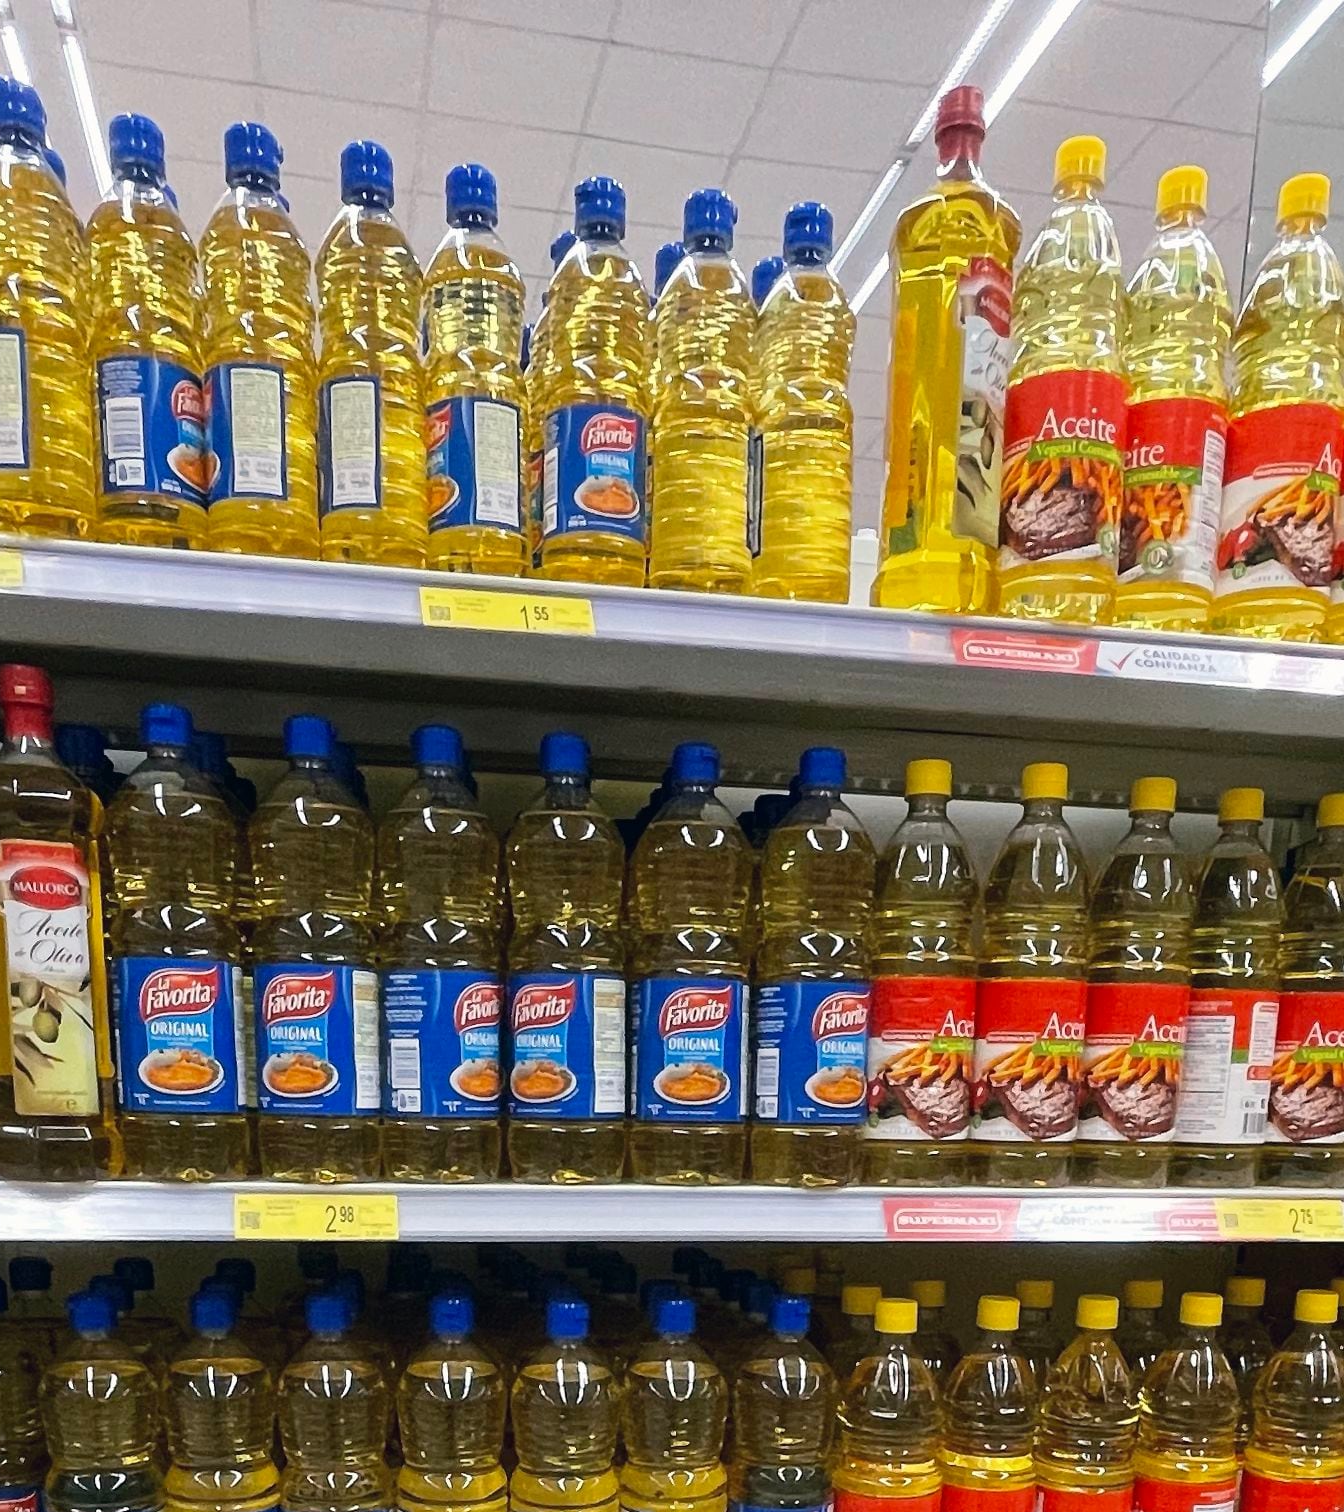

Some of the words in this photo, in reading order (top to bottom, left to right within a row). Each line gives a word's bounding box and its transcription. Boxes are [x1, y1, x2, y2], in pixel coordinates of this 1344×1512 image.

[1036, 407, 1117, 443] Aceite
[587, 426, 634, 449] Favorita
[968, 645, 1075, 663] SUPERMAXI
[1142, 649, 1200, 664] CALIDAD
[1204, 653, 1214, 664] Y
[1134, 658, 1218, 676] CONFIANZA
[13, 880, 81, 897] MALLORCA
[14, 909, 84, 938] Aceite
[29, 939, 85, 965] Oliva
[146, 983, 212, 1015] Favorita
[267, 985, 326, 1019] Favorita
[514, 997, 567, 1026] Favorita
[665, 1001, 726, 1031] Favorita
[150, 1021, 210, 1038] ORIGINAL
[270, 1026, 324, 1043] ORIGINAL
[516, 1033, 563, 1049] ORIGINAL
[668, 1037, 720, 1053] ORIGINAL
[897, 1214, 998, 1229] SUPERMAXI
